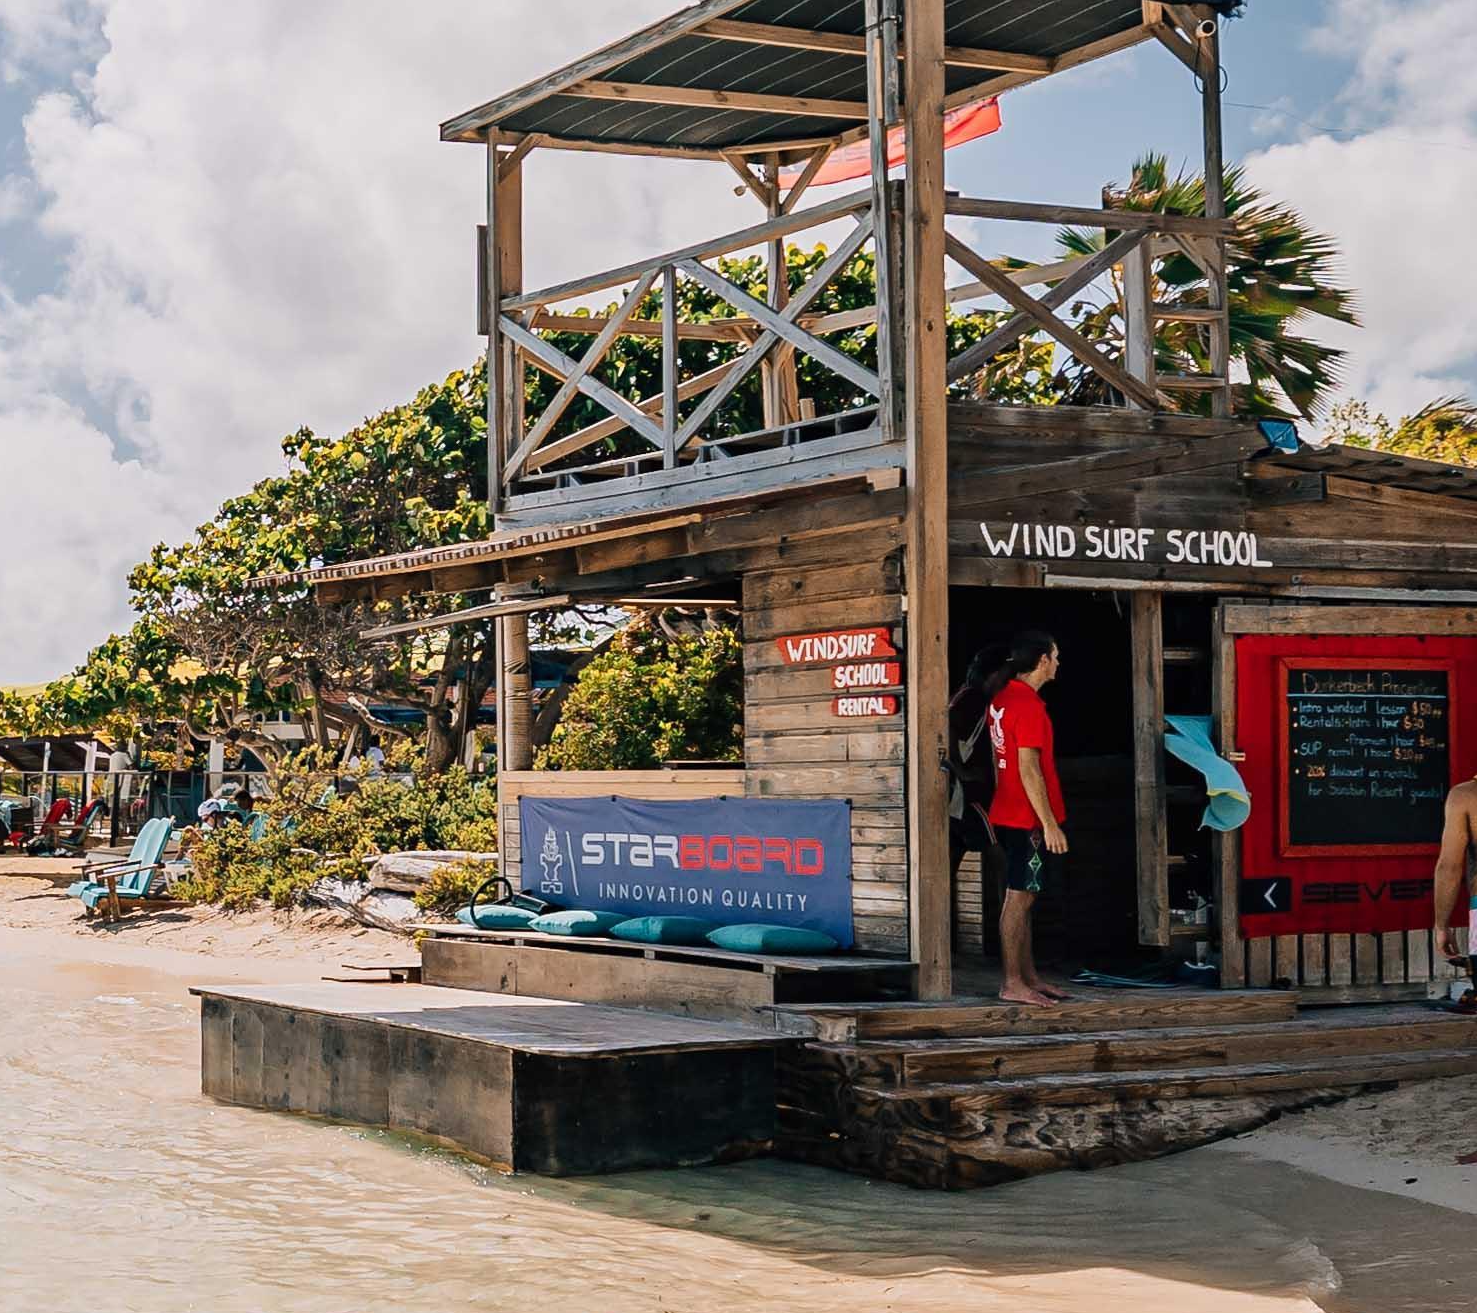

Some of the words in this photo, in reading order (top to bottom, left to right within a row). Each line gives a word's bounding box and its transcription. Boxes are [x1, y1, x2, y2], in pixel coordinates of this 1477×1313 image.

[980, 522, 1076, 558] WIND
[1085, 525, 1154, 562] SURF
[1166, 529, 1273, 567] SCHOOL
[786, 633, 876, 663] WINDSURF
[834, 663, 889, 688] SCHOOL
[837, 697, 888, 716] RENTAL
[1300, 741, 1322, 756] SUP
[598, 882, 713, 906] INNOVATION
[721, 889, 808, 912] QUALITY
